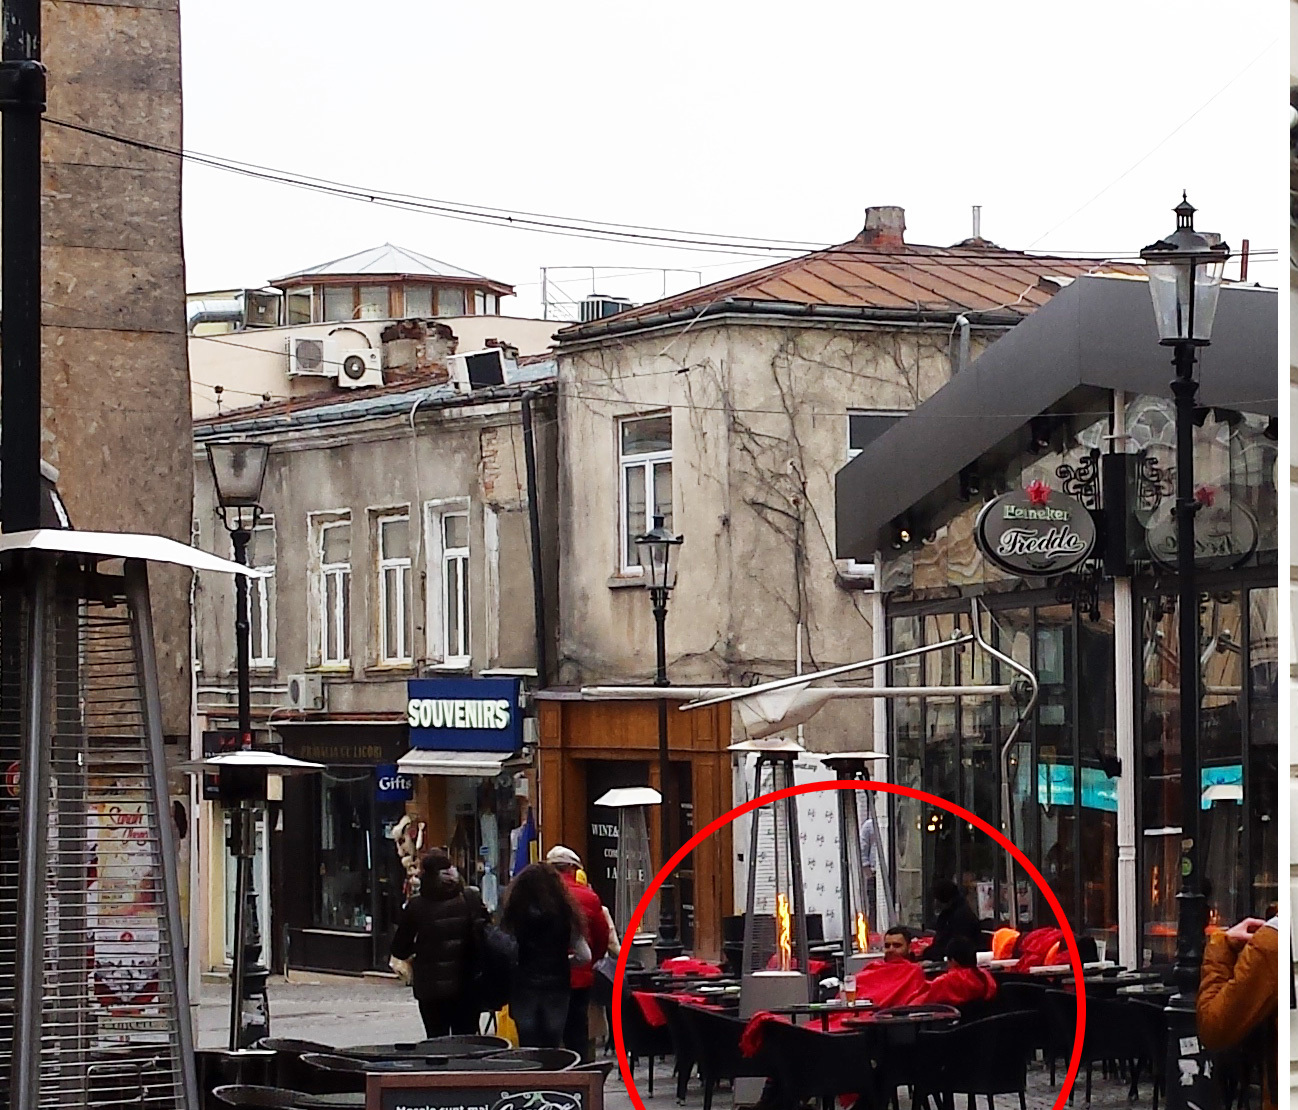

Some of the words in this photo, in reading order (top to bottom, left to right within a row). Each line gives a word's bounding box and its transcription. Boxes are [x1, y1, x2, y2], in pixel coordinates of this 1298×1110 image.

[997, 525, 1087, 558] Freddo
[408, 699, 511, 730] SOUVENIRS
[378, 776, 412, 791] Gifts
